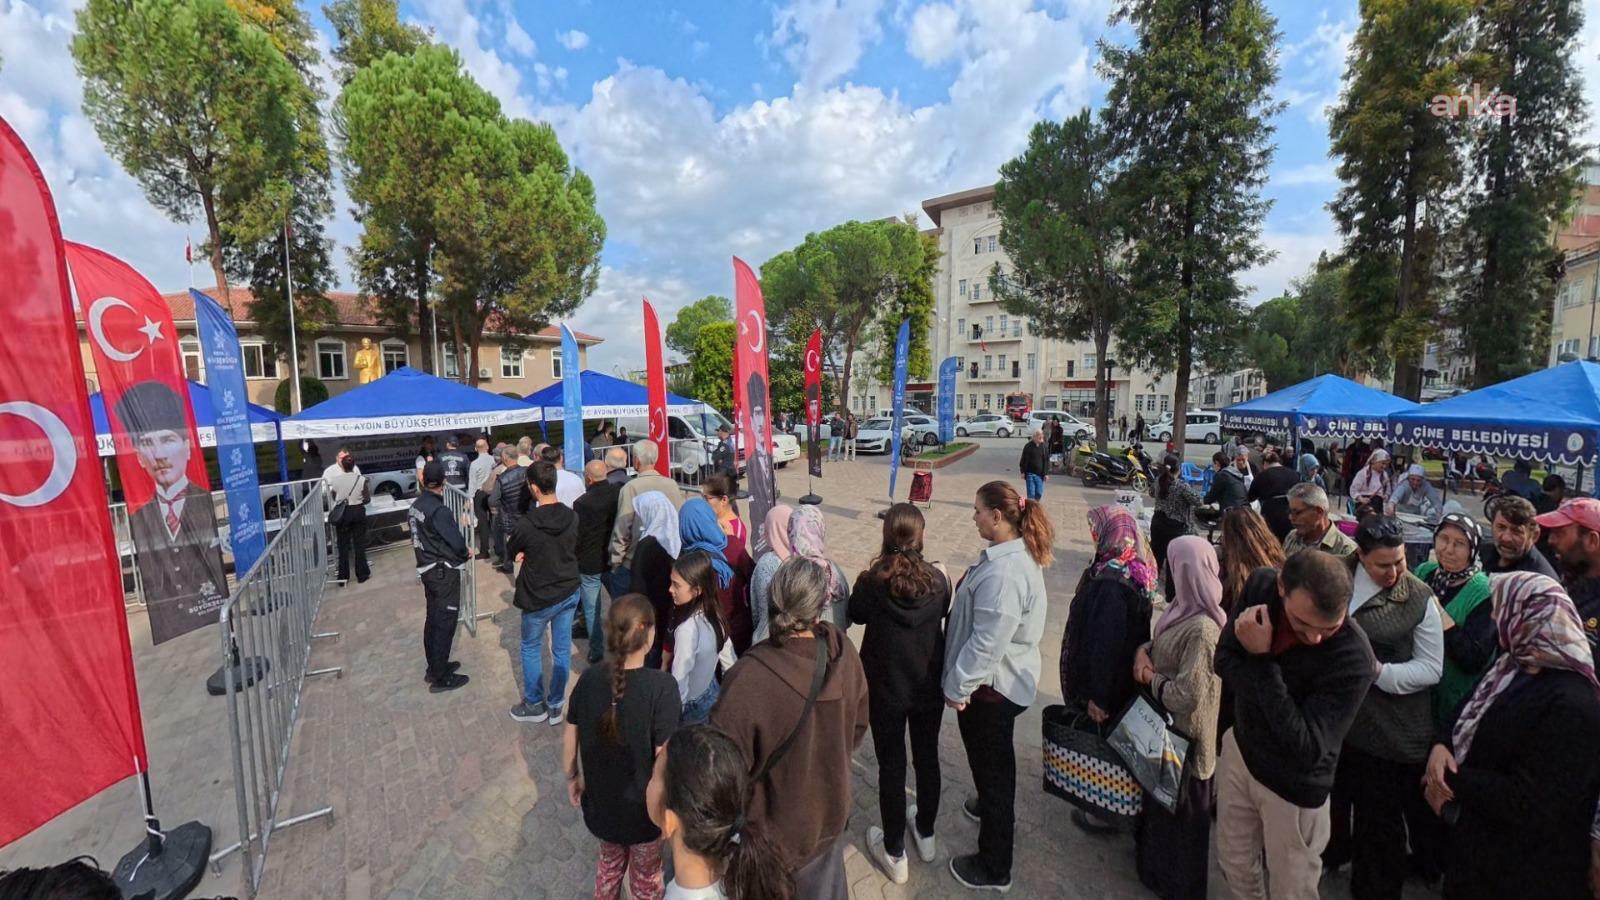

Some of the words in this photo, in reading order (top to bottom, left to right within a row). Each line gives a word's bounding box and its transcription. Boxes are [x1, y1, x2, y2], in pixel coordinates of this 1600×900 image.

[354, 421, 382, 430] AYDIN
[384, 416, 451, 430] BÜYÜKŞEHİR
[1328, 419, 1357, 432] ÇİNE
[1412, 424, 1445, 440] ÇİNE
[1451, 428, 1549, 449] BELEDİYESİ
